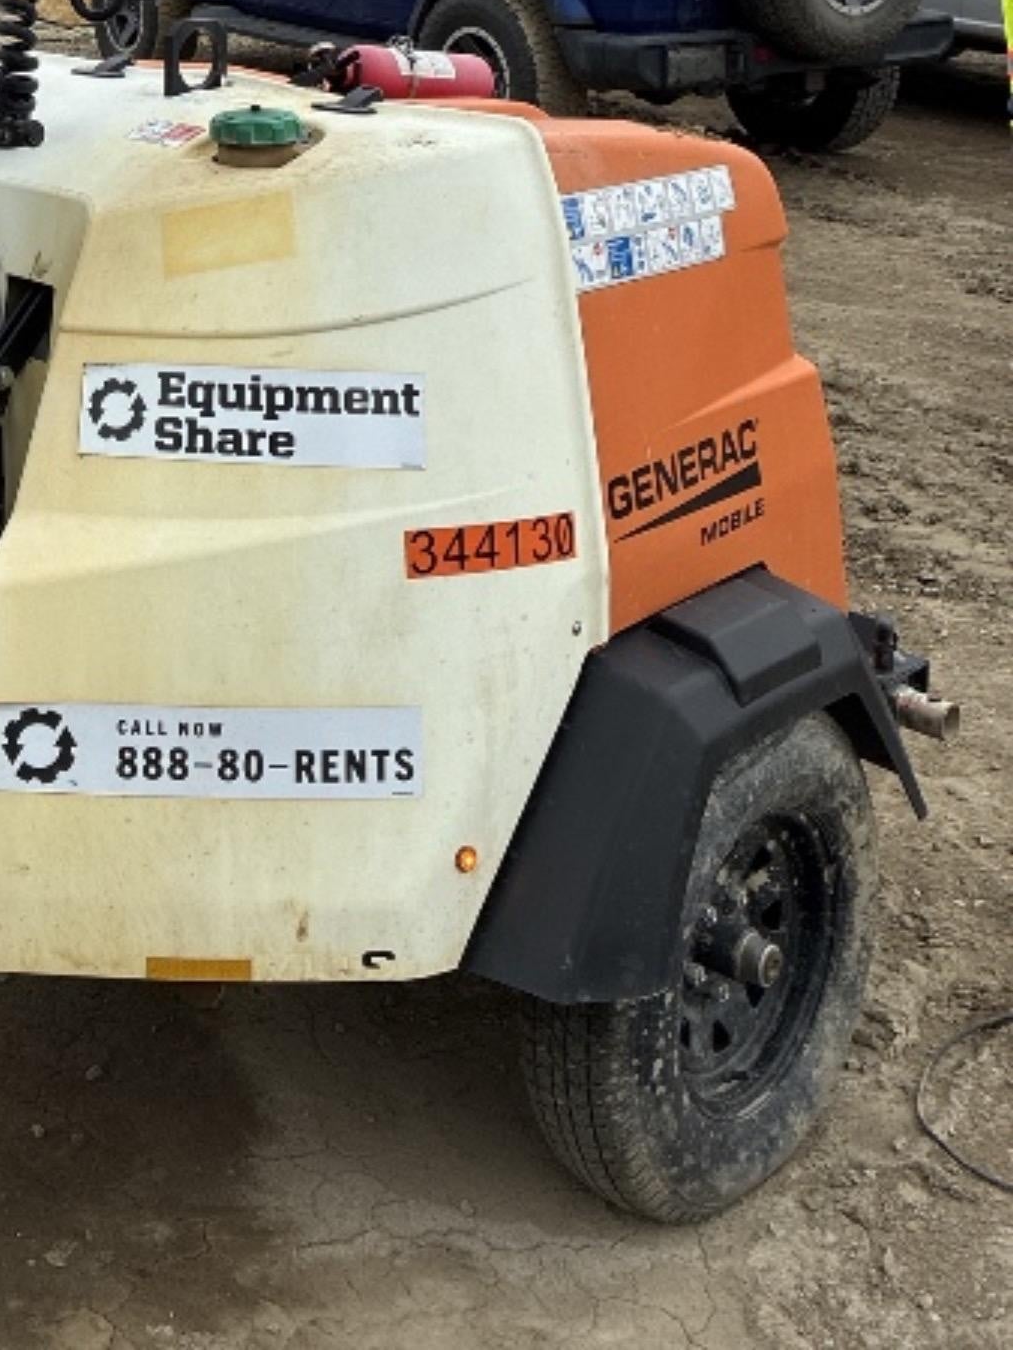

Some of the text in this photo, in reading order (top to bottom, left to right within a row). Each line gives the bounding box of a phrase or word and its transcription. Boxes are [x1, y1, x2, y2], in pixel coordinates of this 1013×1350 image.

[157, 371, 421, 421] Equipment
[154, 416, 296, 458] Share
[607, 418, 759, 520] GENERAC
[409, 513, 574, 575] 344130
[700, 498, 765, 546] MOBILE
[116, 719, 224, 739] CALL NOW
[116, 746, 415, 783] 888-80-RENTS
